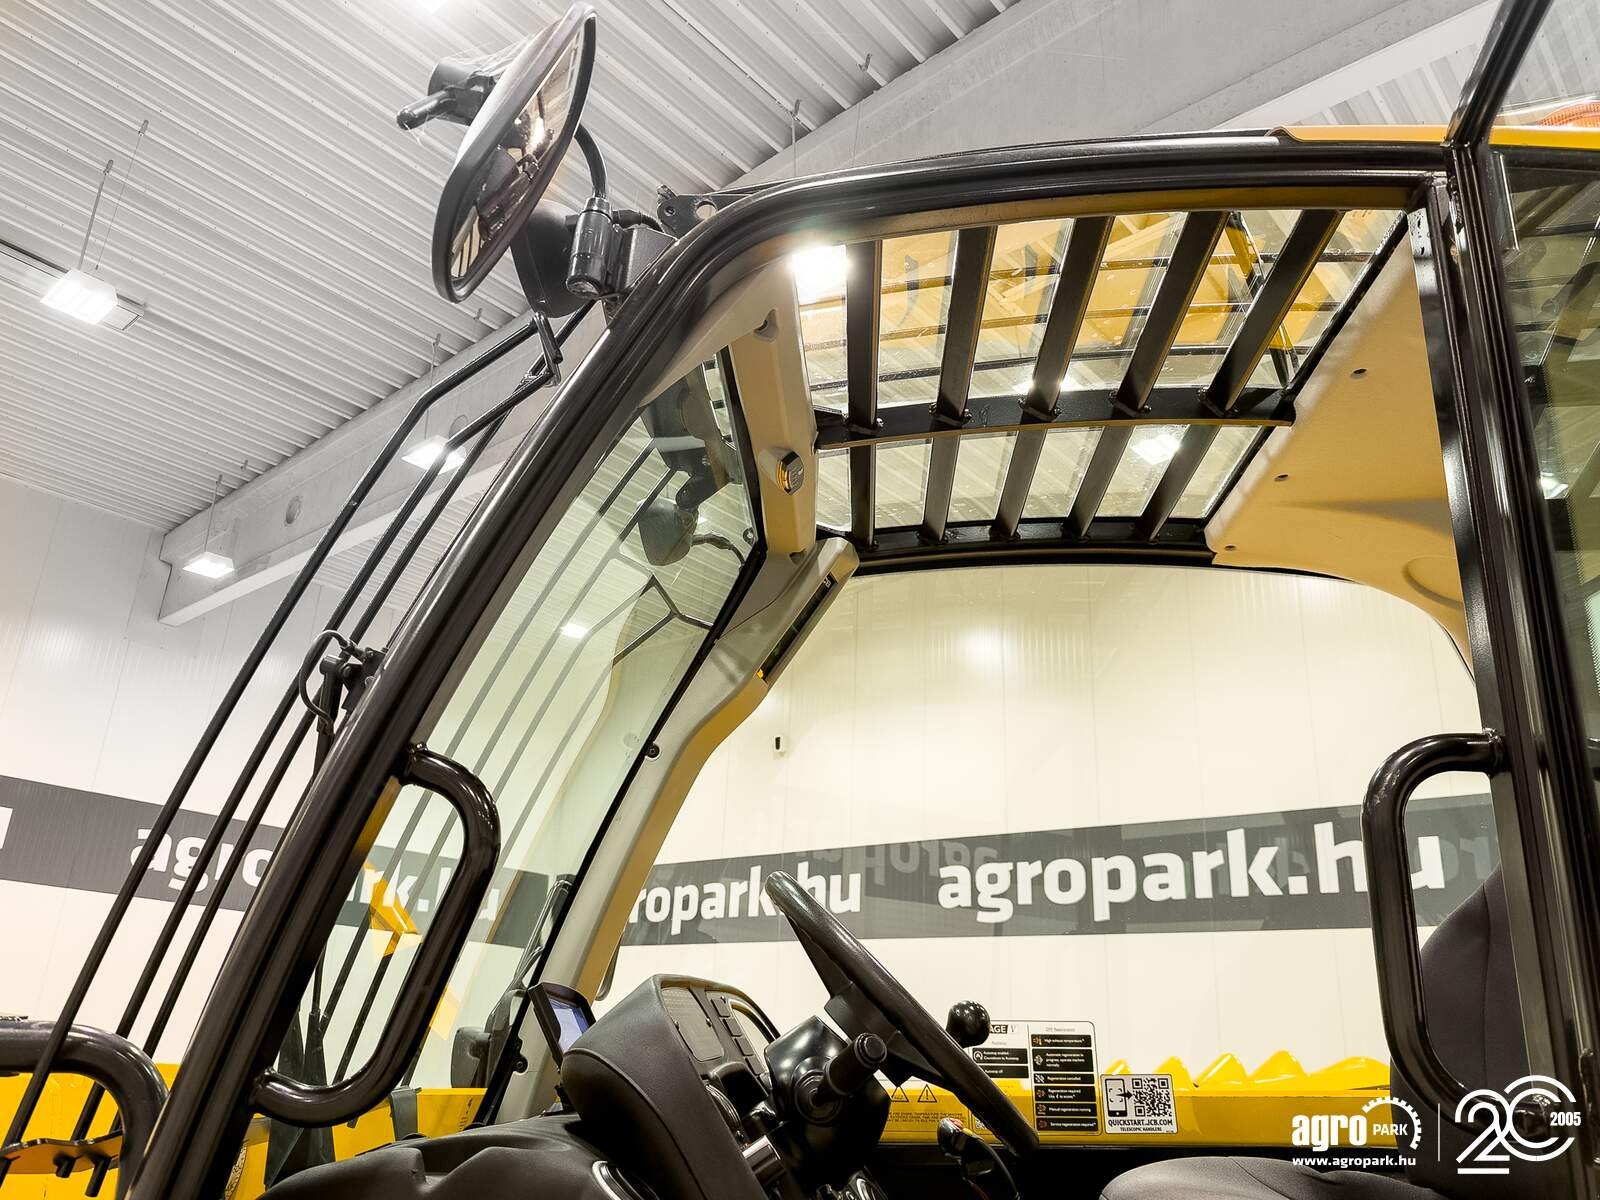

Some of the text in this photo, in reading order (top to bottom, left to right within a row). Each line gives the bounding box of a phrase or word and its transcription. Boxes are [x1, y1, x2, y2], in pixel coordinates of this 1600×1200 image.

[938, 821, 1445, 923] agropark.hu
[989, 1025, 1006, 1033] AGE
[1108, 1119, 1173, 1127] QUICKSTART.JCB.COM
